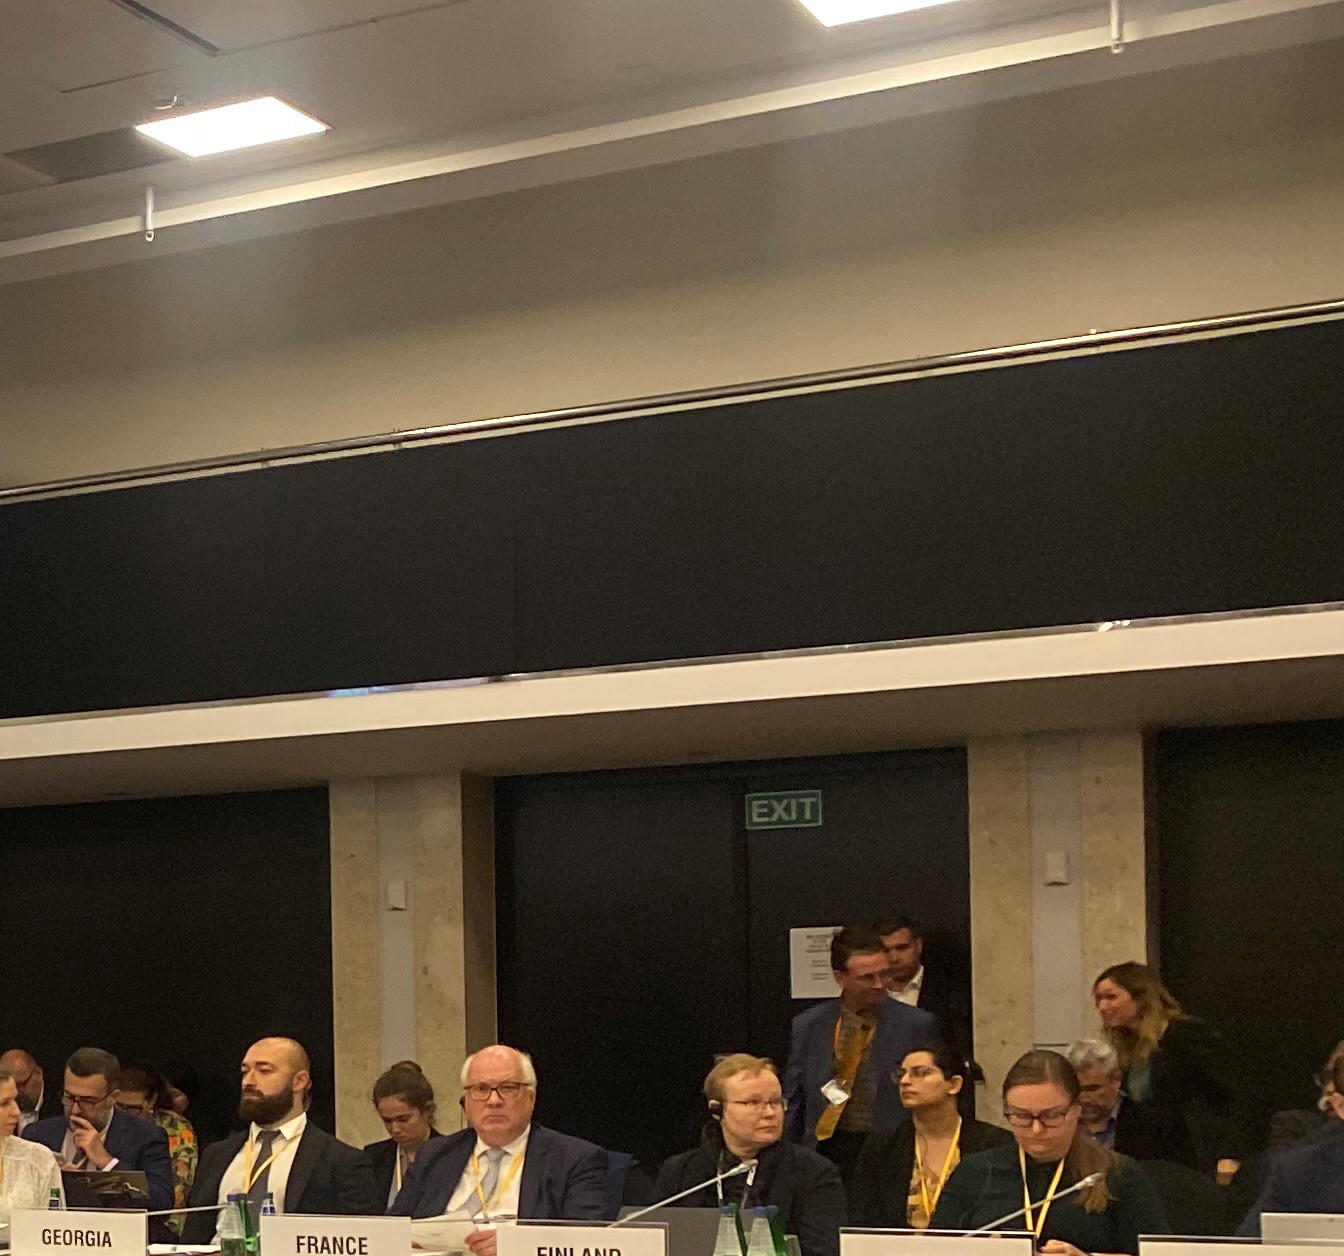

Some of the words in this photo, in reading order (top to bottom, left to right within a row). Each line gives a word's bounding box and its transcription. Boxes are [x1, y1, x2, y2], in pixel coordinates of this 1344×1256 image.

[751, 797, 817, 823] EXIT
[41, 1228, 112, 1248] GEORGIA
[296, 1235, 369, 1256] FRANCE
